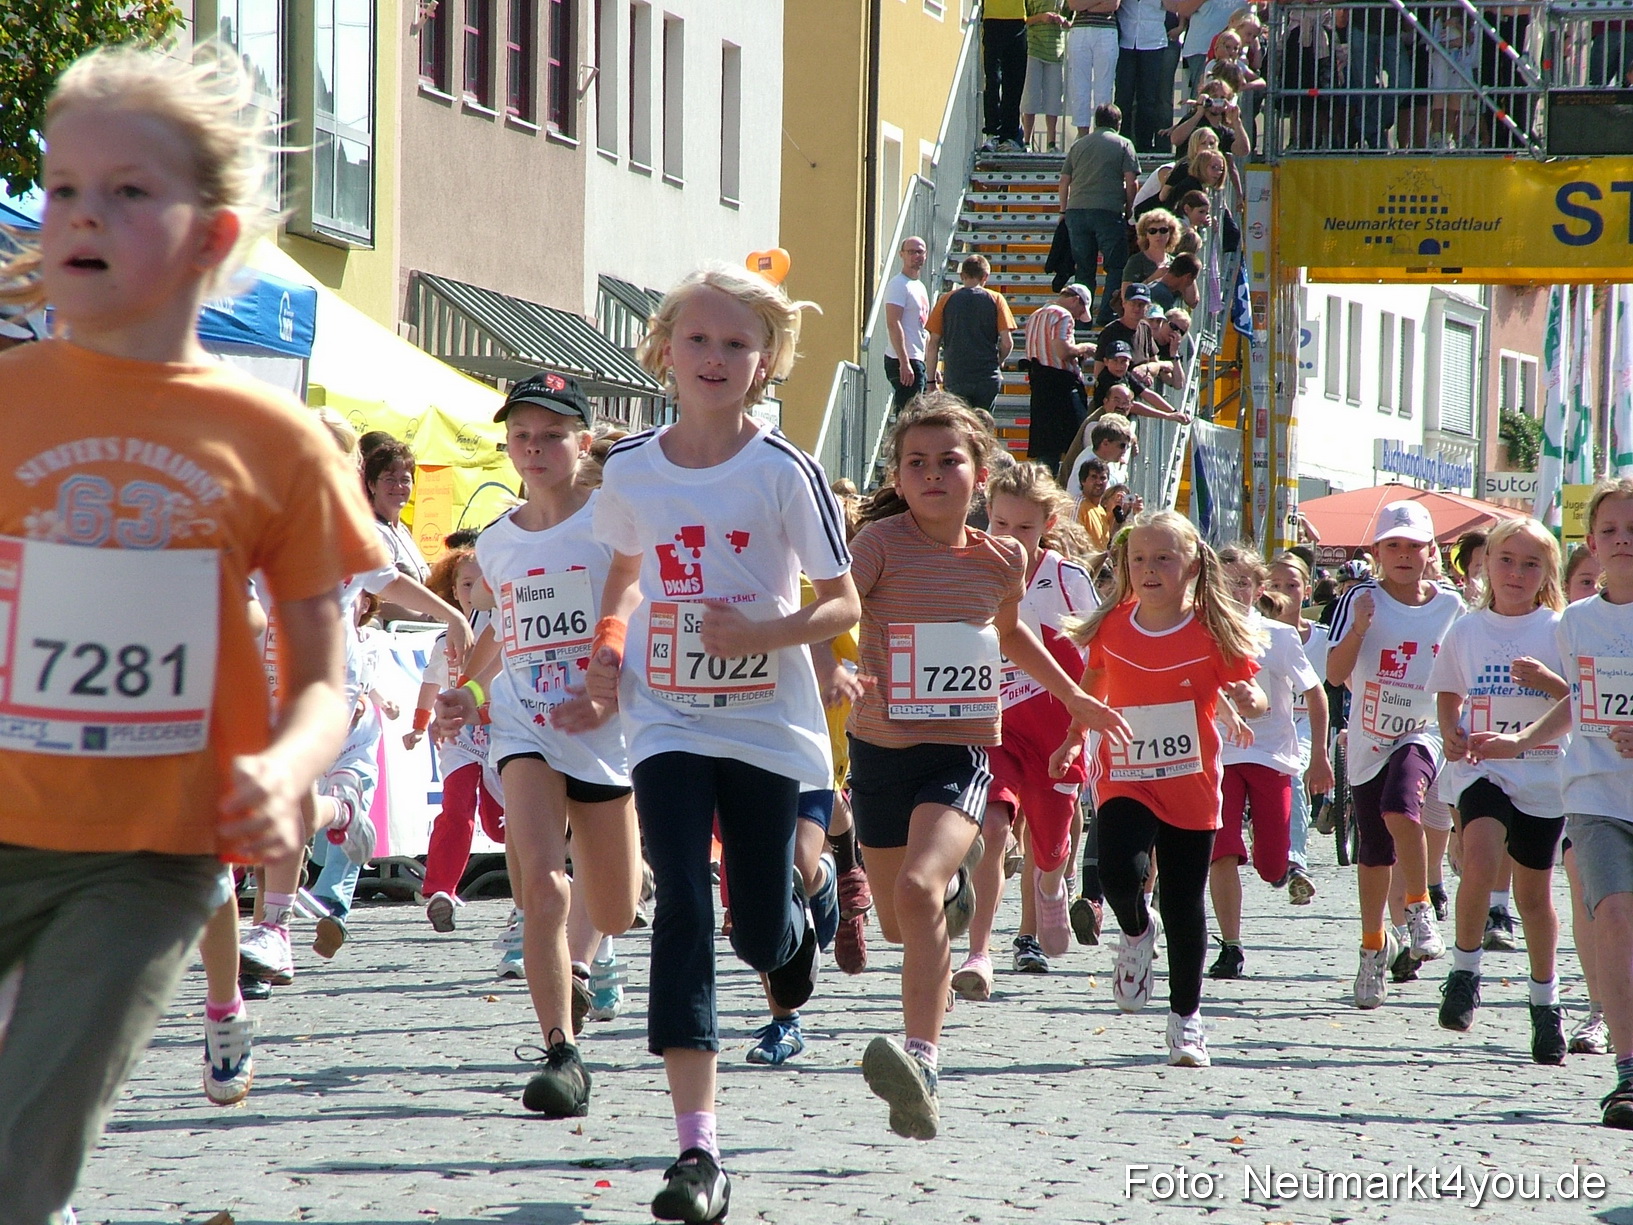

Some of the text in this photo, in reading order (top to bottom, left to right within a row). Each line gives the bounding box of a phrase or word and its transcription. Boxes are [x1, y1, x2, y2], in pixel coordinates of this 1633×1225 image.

[1323, 216, 1503, 232] Neumarkter Stadtlauf
[57, 473, 174, 551] 63
[1563, 500, 1586, 512] Juge
[515, 585, 555, 604] Milena
[664, 576, 701, 595] DKMS
[520, 610, 588, 642] 7046
[683, 613, 703, 634] Sa
[556, 643, 592, 656] PFLEIDERE
[652, 643, 669, 659] K3
[32, 637, 188, 698] 7281
[686, 652, 769, 681] 7022
[923, 665, 993, 693] 7228
[728, 690, 775, 702] PFLEIDERER
[1008, 683, 1031, 701] DEHN
[1381, 690, 1412, 708] Selina
[962, 702, 998, 713] PFLEIDERER
[1365, 704, 1374, 715] K3
[1601, 692, 1633, 716] 72
[1132, 734, 1192, 761] 7189
